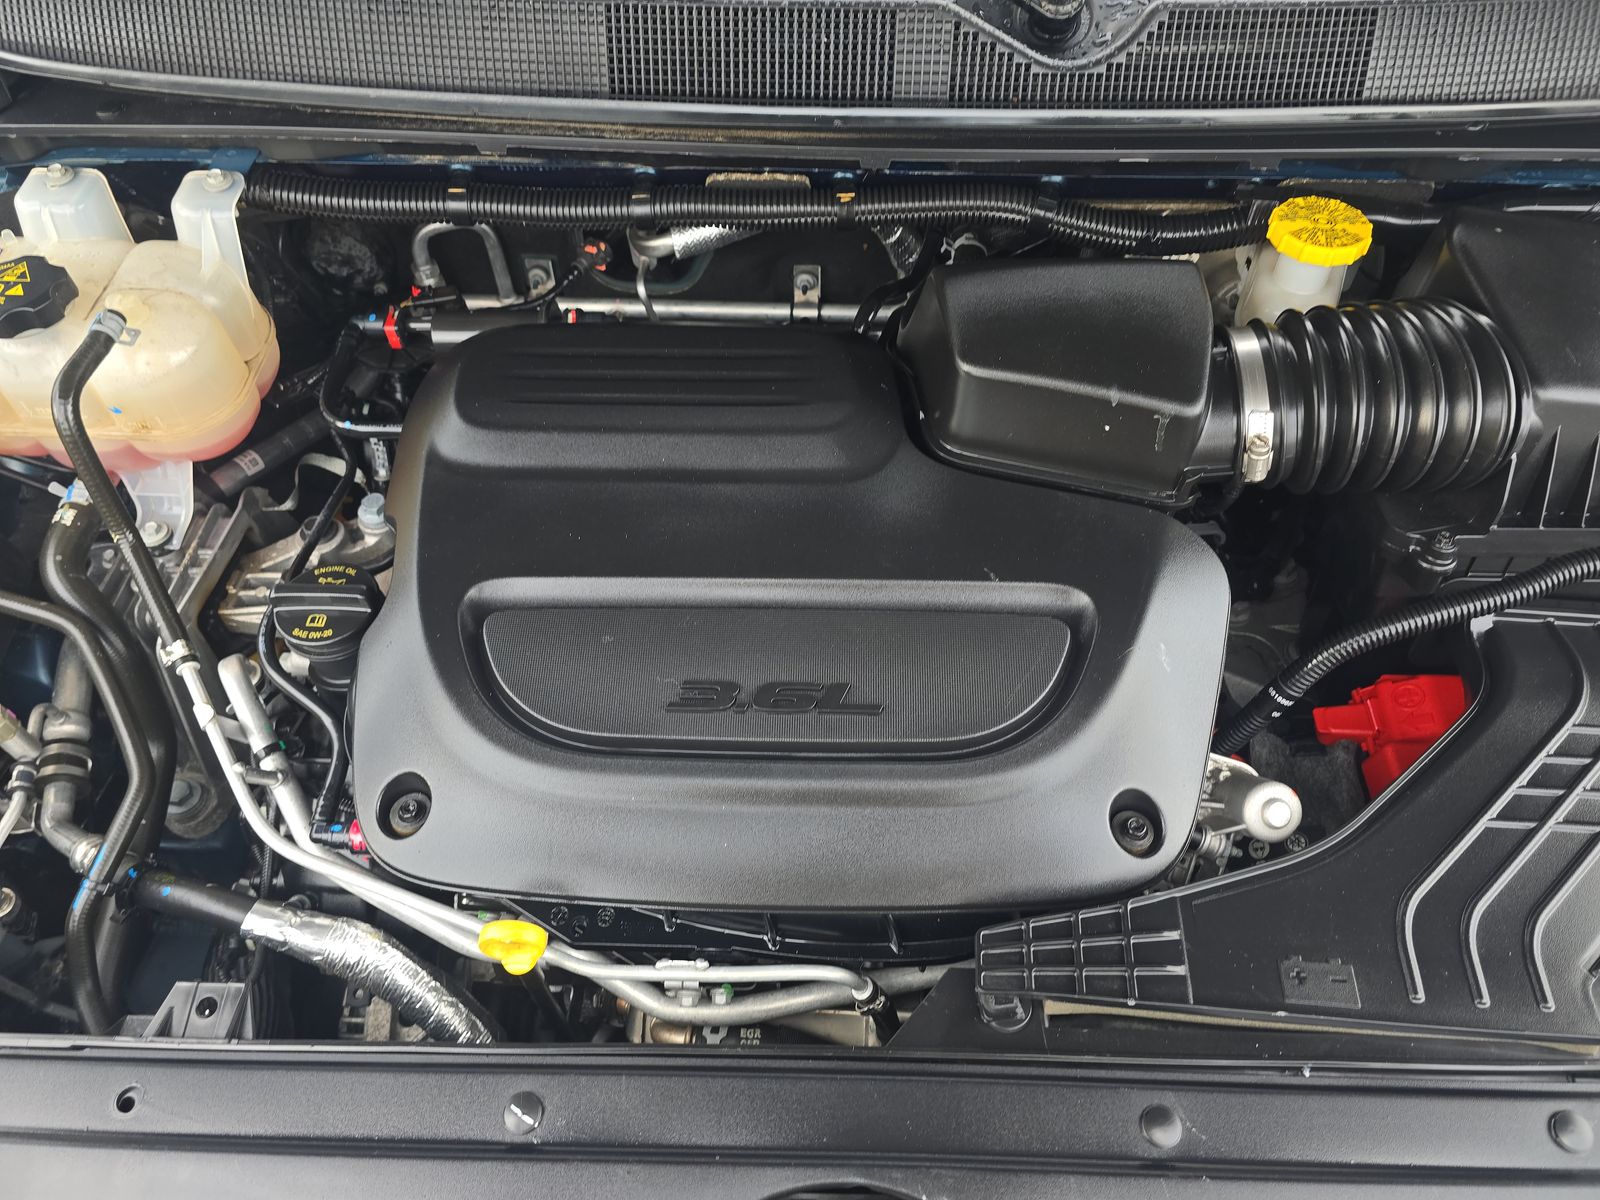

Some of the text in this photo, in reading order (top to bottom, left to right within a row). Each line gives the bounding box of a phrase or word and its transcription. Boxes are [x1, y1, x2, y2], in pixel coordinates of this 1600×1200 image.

[314, 565, 357, 577] ENGINE OIL
[292, 628, 333, 640] SAE 0W-20
[665, 679, 884, 717] 3.6L
